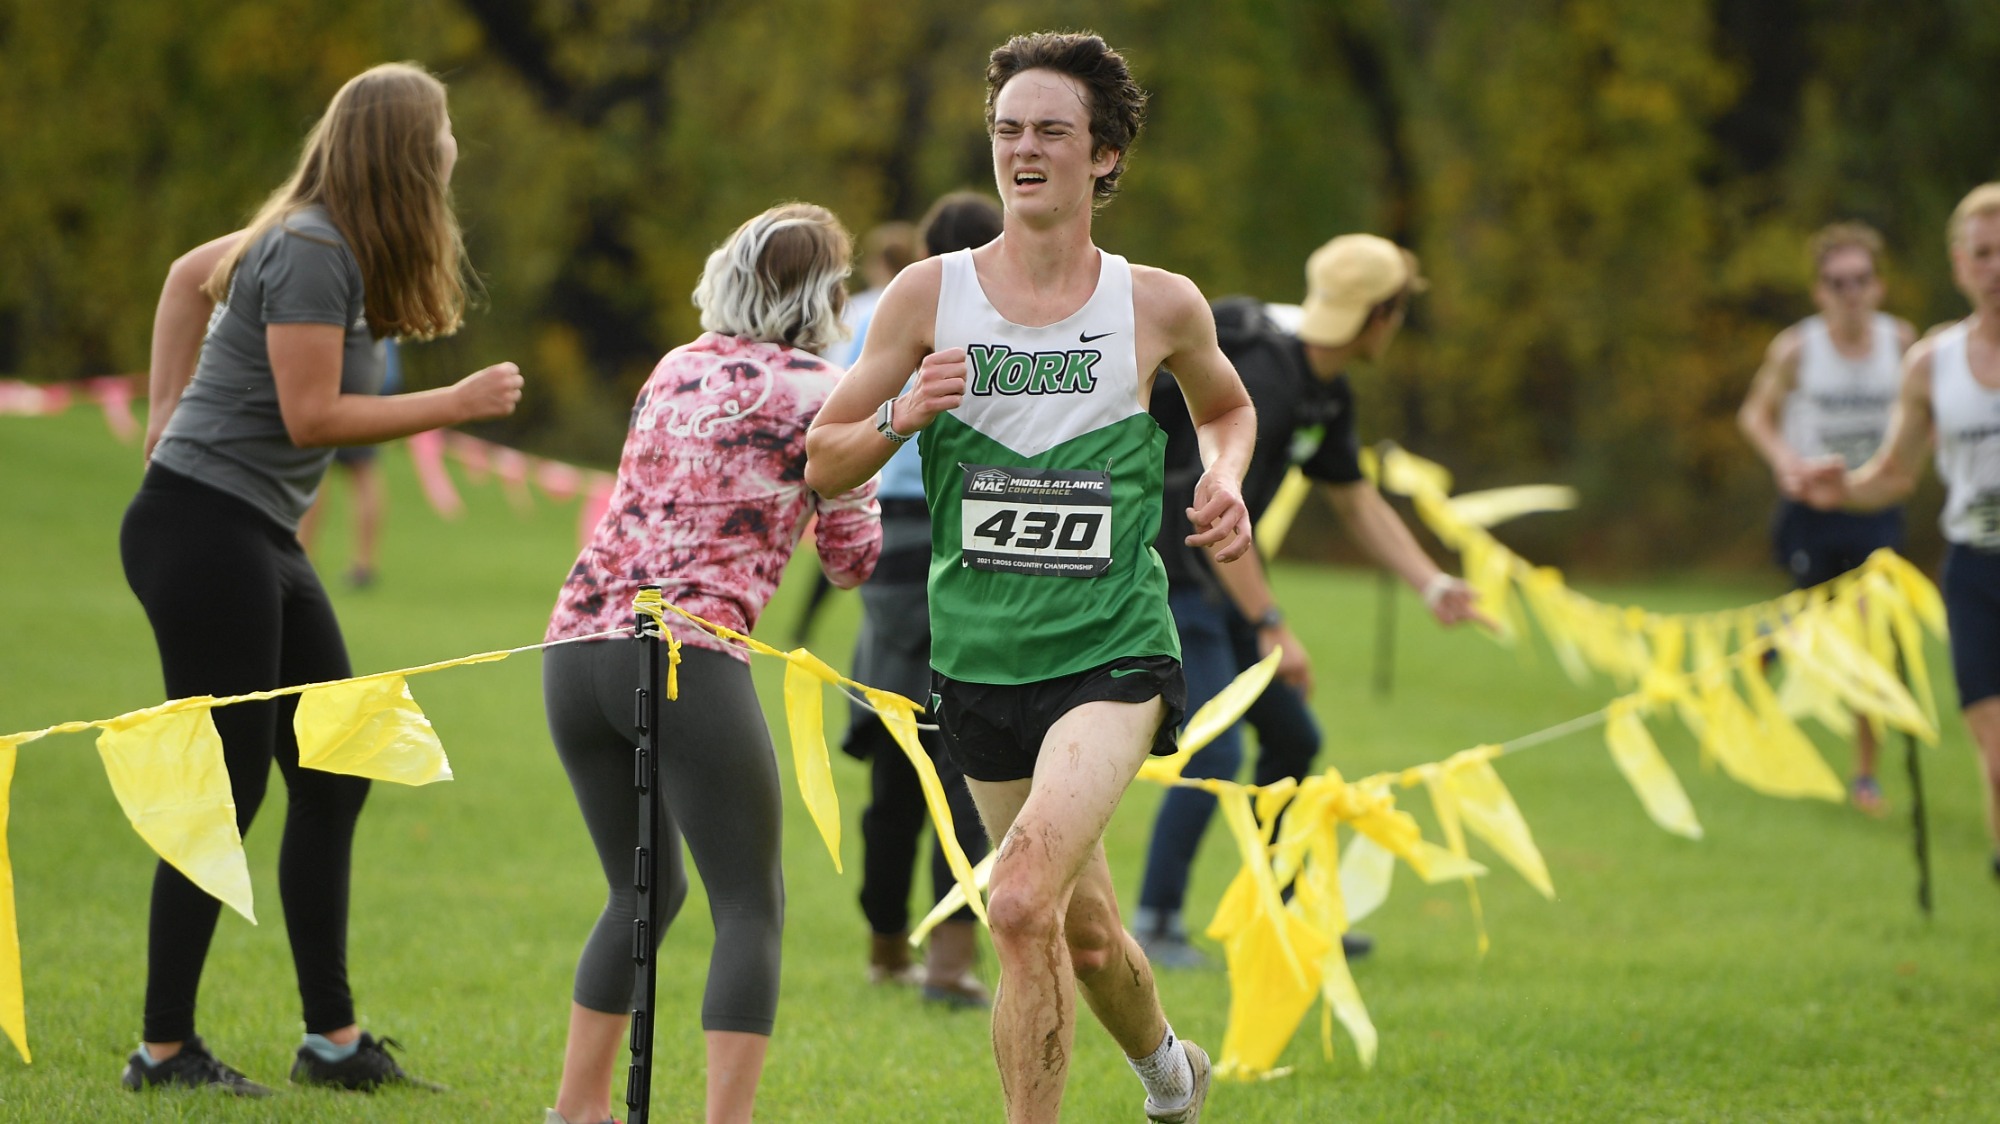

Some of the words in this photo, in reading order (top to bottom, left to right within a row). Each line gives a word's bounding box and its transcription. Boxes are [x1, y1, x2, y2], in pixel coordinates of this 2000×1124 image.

[967, 344, 1102, 396] YORK
[972, 481, 1006, 492] MAC
[1010, 478, 1051, 488] MIDDLE
[1051, 480, 1104, 490] ATLANTIC
[973, 509, 1104, 551] 430
[976, 557, 991, 565] 2021
[1013, 561, 1043, 569] COUNTRY
[1044, 562, 1094, 571] CHAMPIONSHIP
